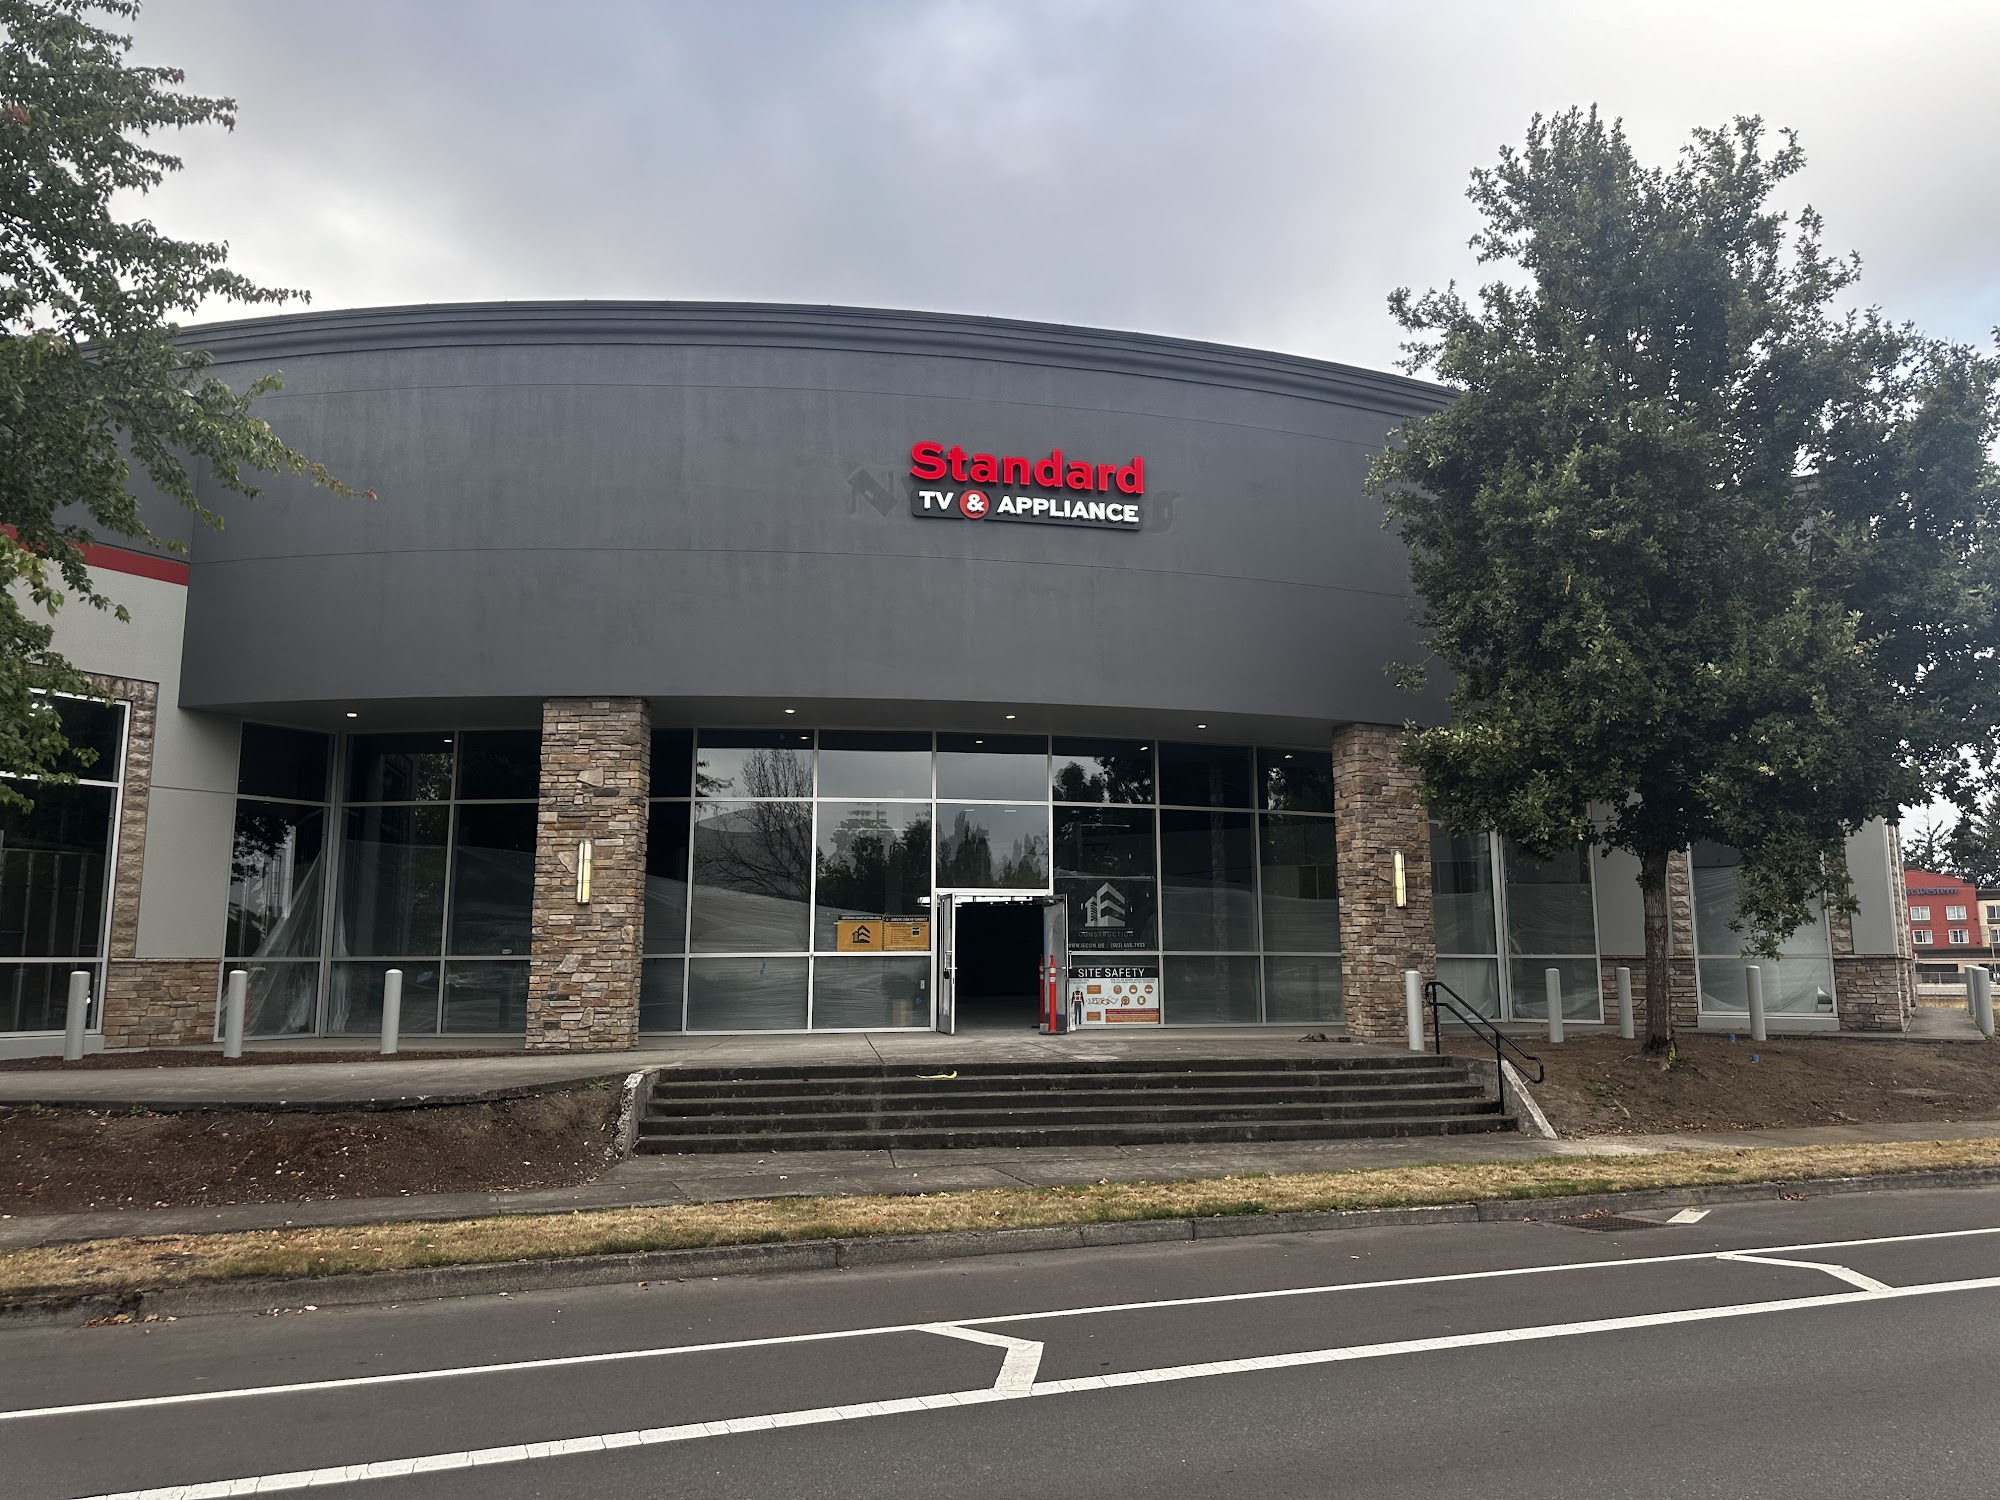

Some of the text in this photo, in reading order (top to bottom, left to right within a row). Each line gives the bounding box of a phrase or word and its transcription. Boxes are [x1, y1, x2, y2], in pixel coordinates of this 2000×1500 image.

[910, 441, 1145, 495] Standard
[918, 490, 955, 512] TV
[966, 492, 985, 513] &
[997, 495, 1140, 524] APPLIANCE
[1916, 887, 1957, 896] Western
[1077, 968, 1146, 978] SITE SAFETY
